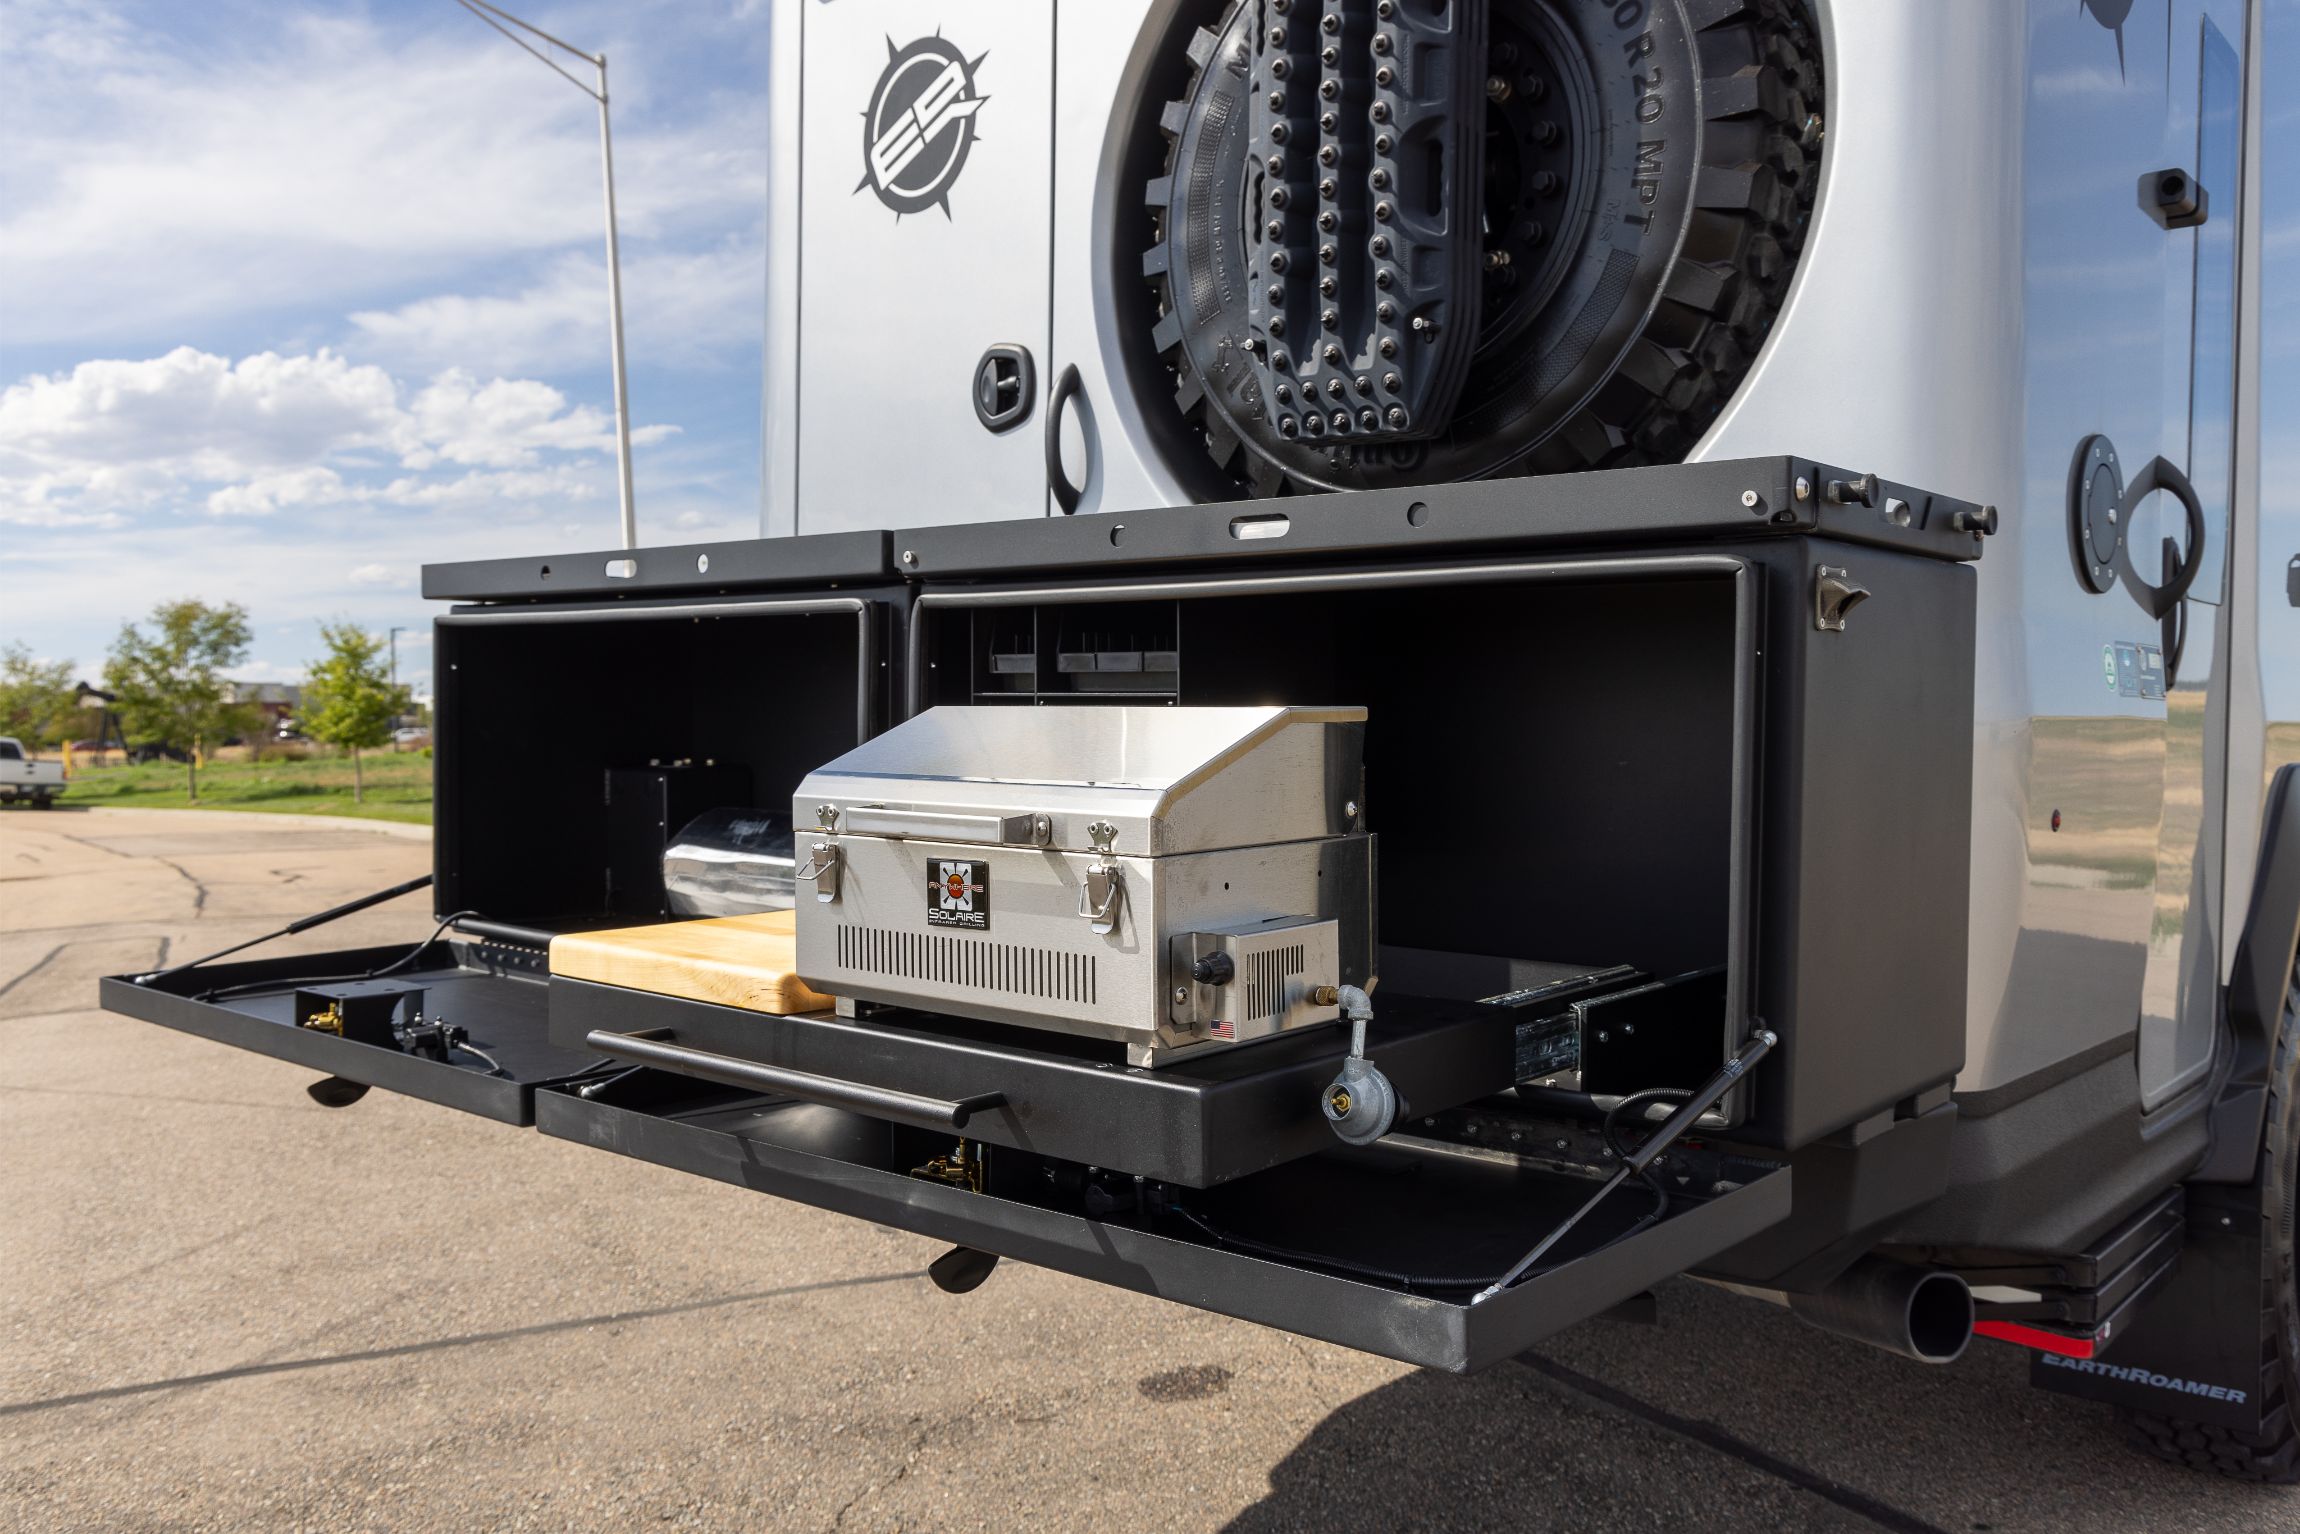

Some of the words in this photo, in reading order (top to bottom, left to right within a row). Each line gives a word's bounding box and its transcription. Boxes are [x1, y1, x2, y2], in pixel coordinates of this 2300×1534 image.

[1623, 139, 1667, 236] MPT
[928, 908, 985, 923] SOLAIRE
[2041, 1353, 2248, 1404] EARTHROAMER
